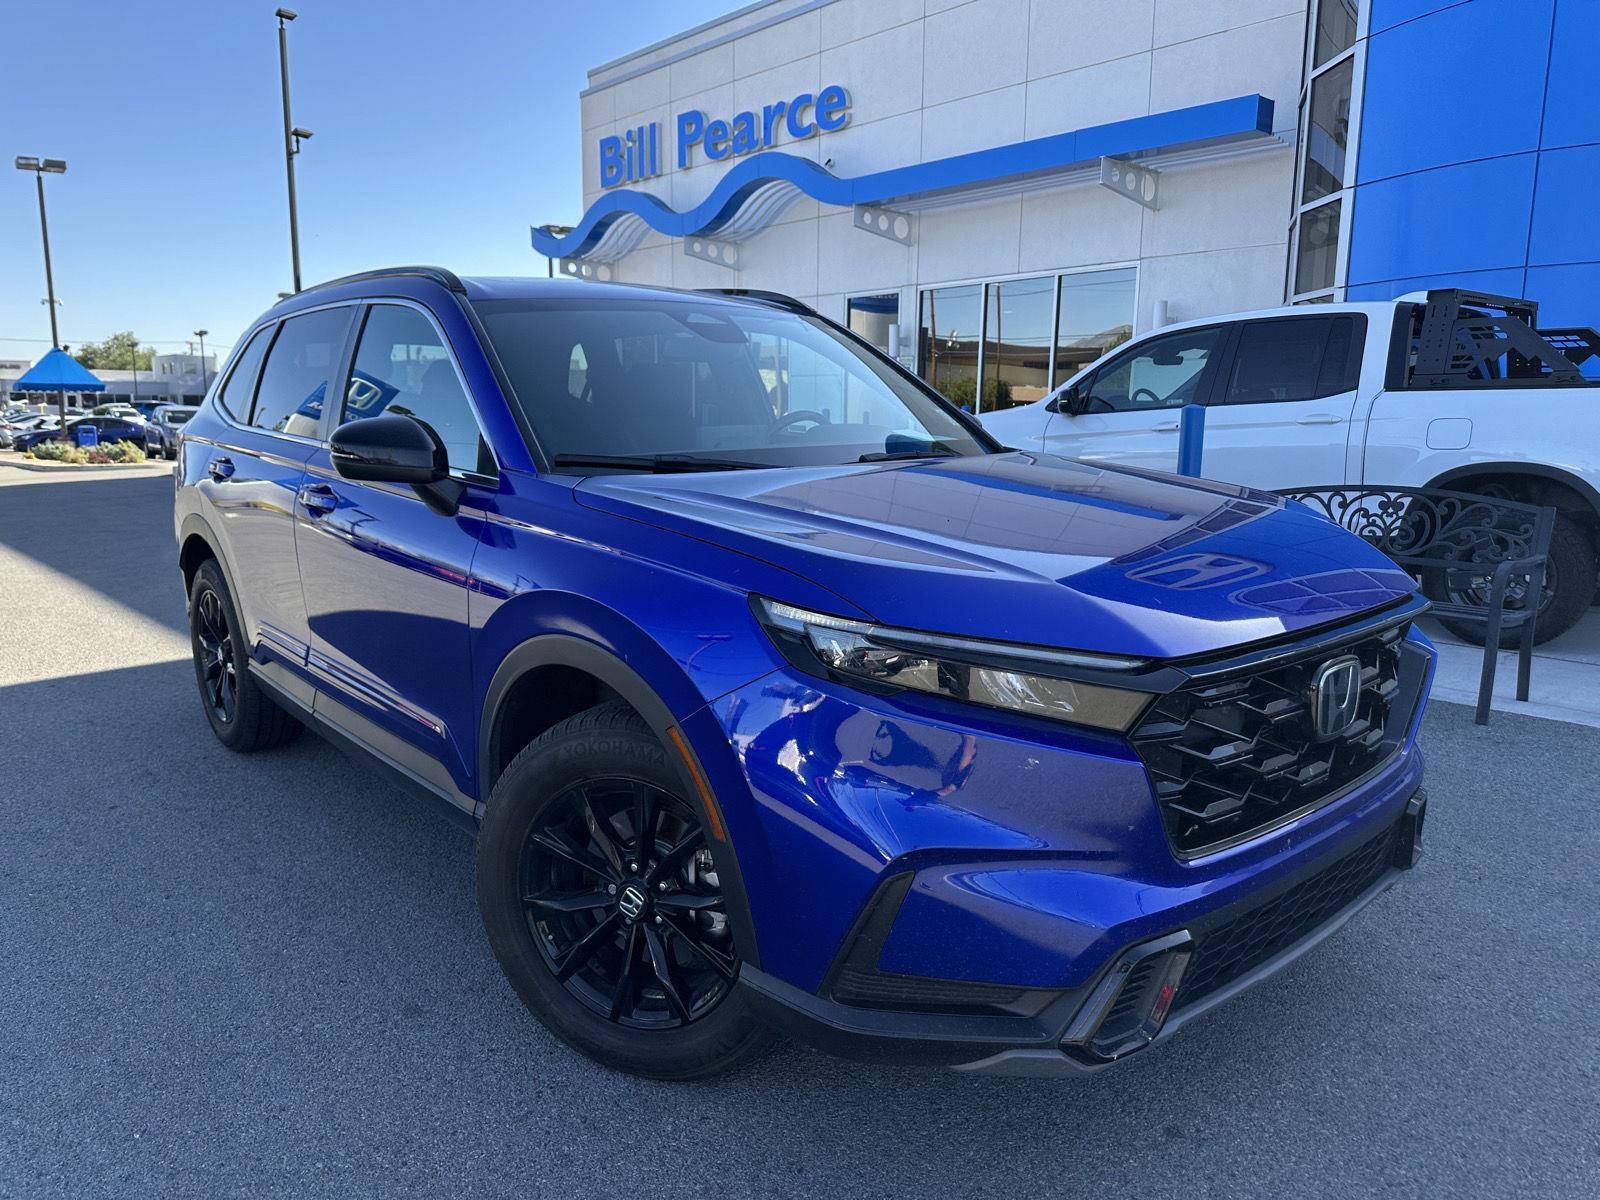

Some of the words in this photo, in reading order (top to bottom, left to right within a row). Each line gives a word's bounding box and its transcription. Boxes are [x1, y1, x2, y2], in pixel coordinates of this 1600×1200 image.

[600, 122, 660, 189] Bill
[677, 85, 850, 169] Pearce
[564, 740, 667, 769] YOKOHAMA
